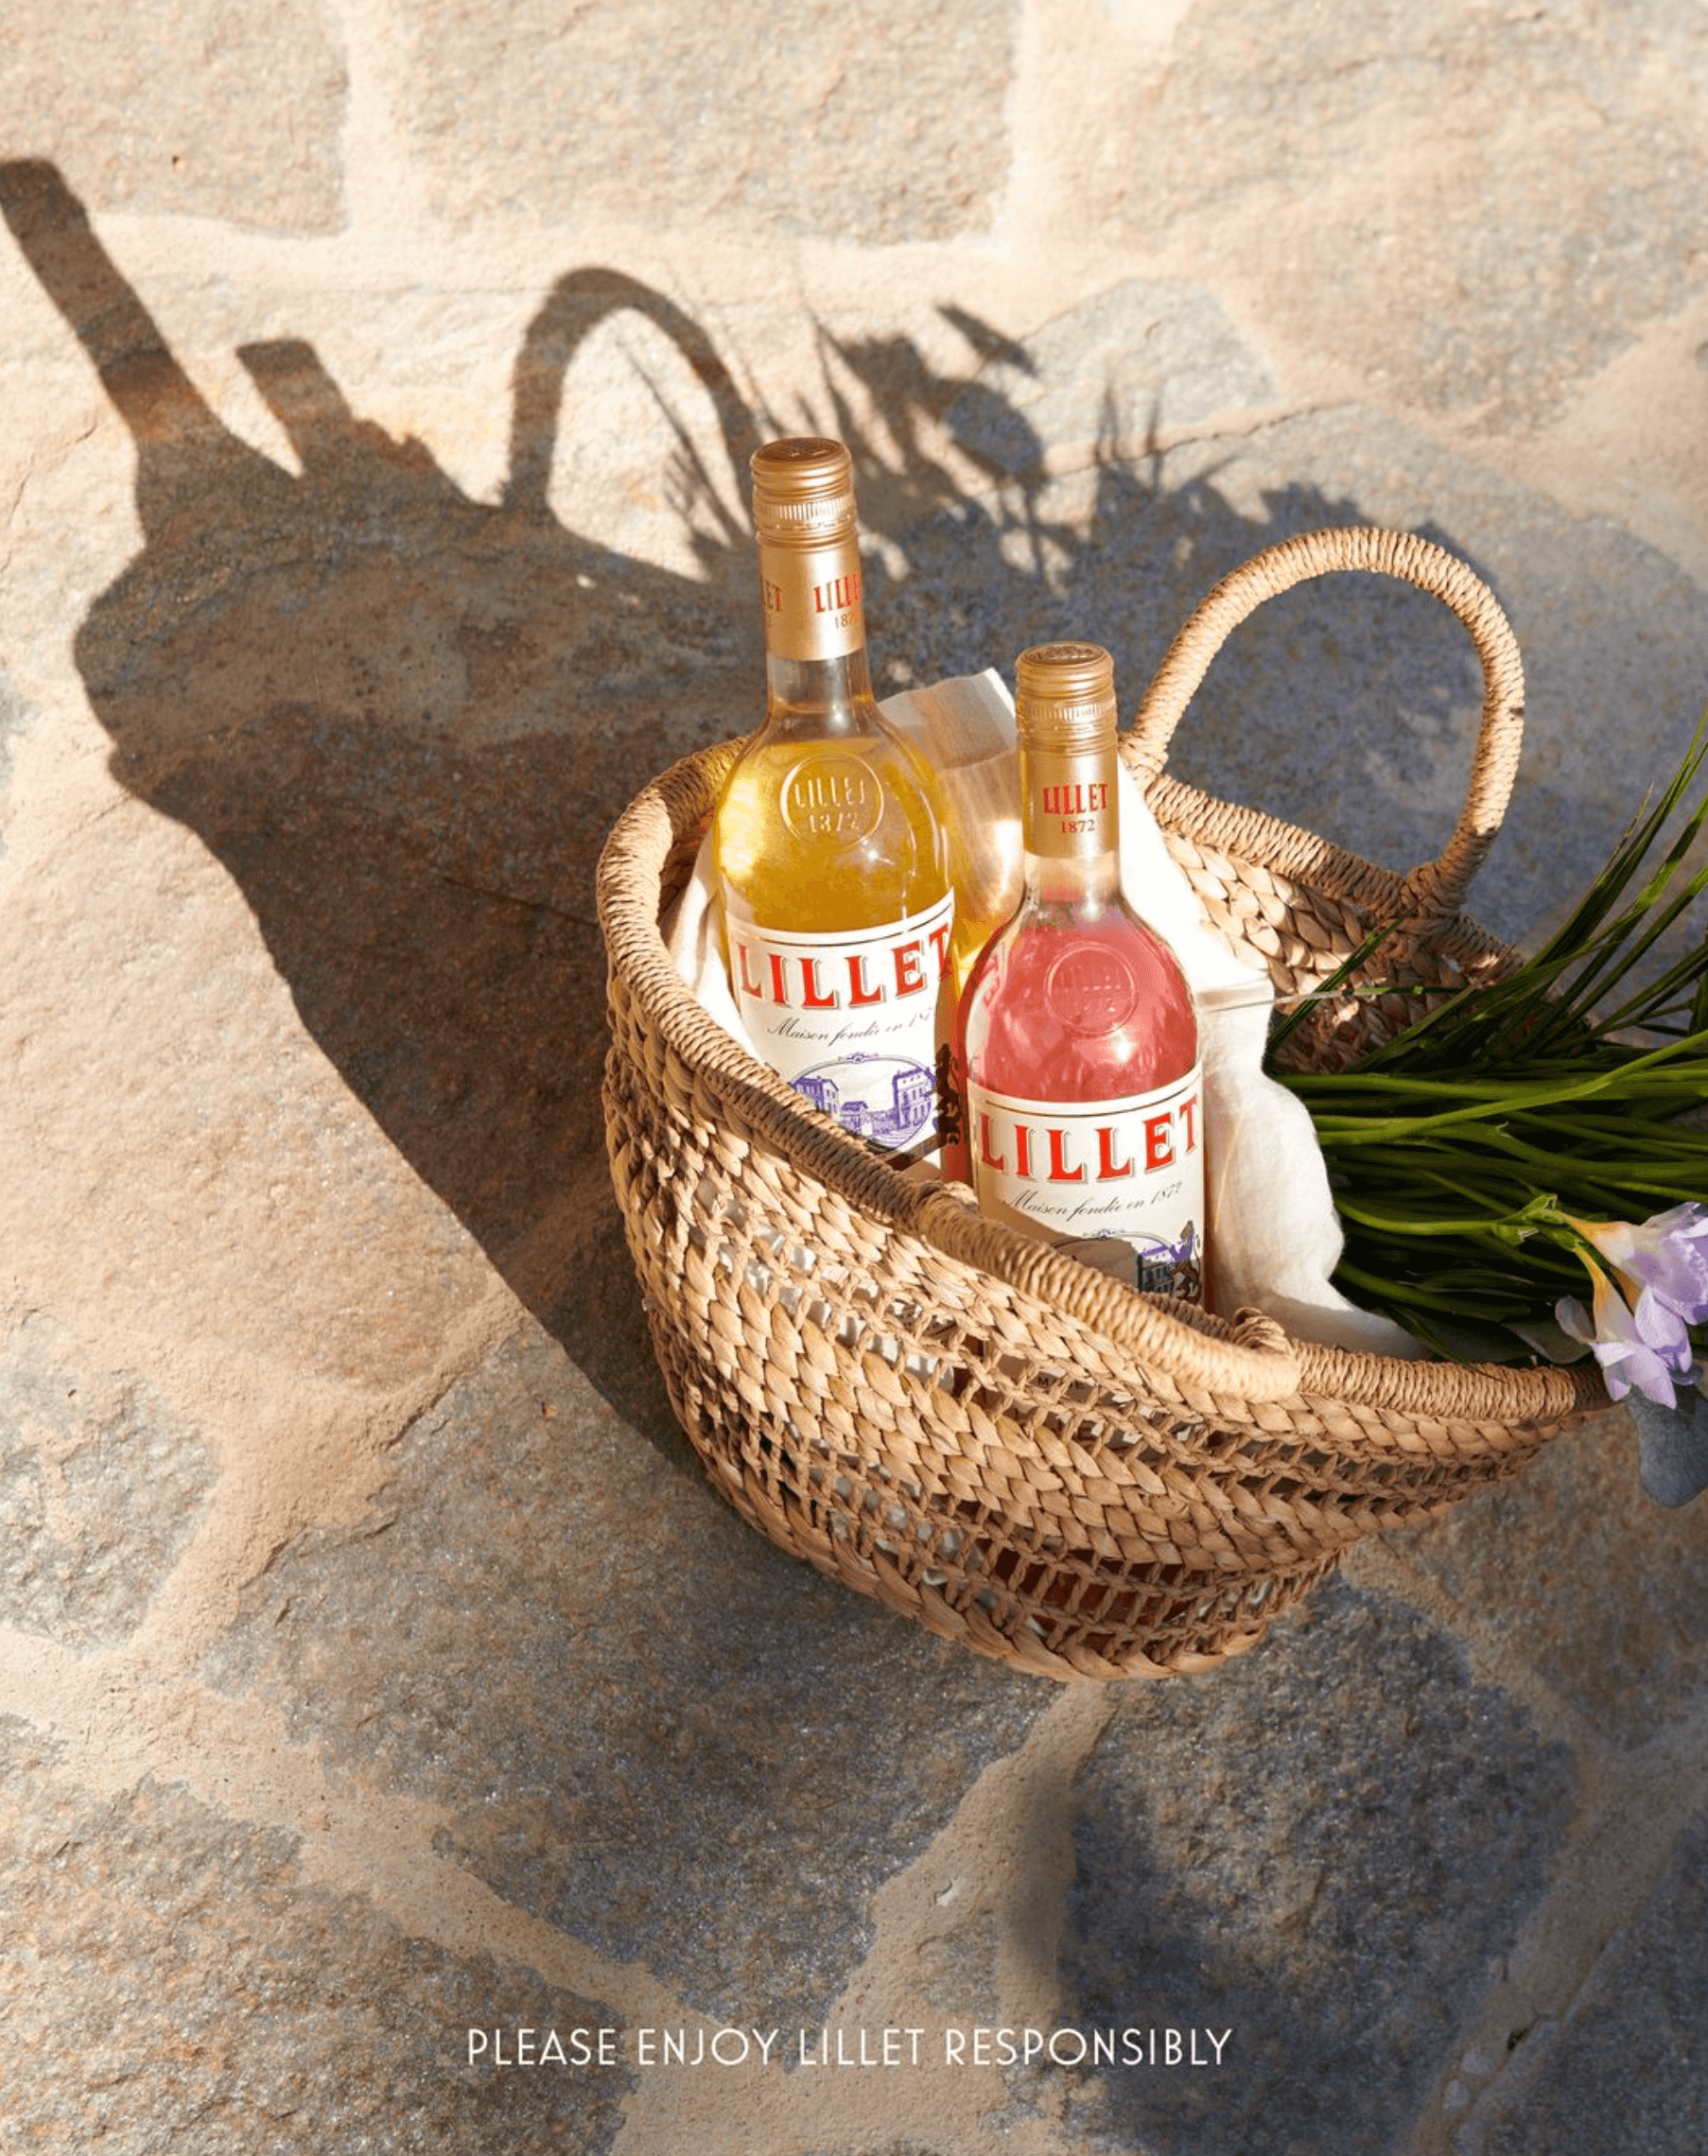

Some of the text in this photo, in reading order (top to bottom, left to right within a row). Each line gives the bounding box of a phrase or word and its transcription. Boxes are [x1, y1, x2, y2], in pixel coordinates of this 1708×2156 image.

[1042, 783, 1108, 815] LILLET
[1061, 819, 1095, 834] 1872
[738, 923, 950, 1009] LILLET
[767, 1016, 828, 1039] Maison
[980, 1094, 1199, 1184] LILLET
[1010, 1189, 1068, 1215] Maison
[1126, 1200, 1144, 1210] en
